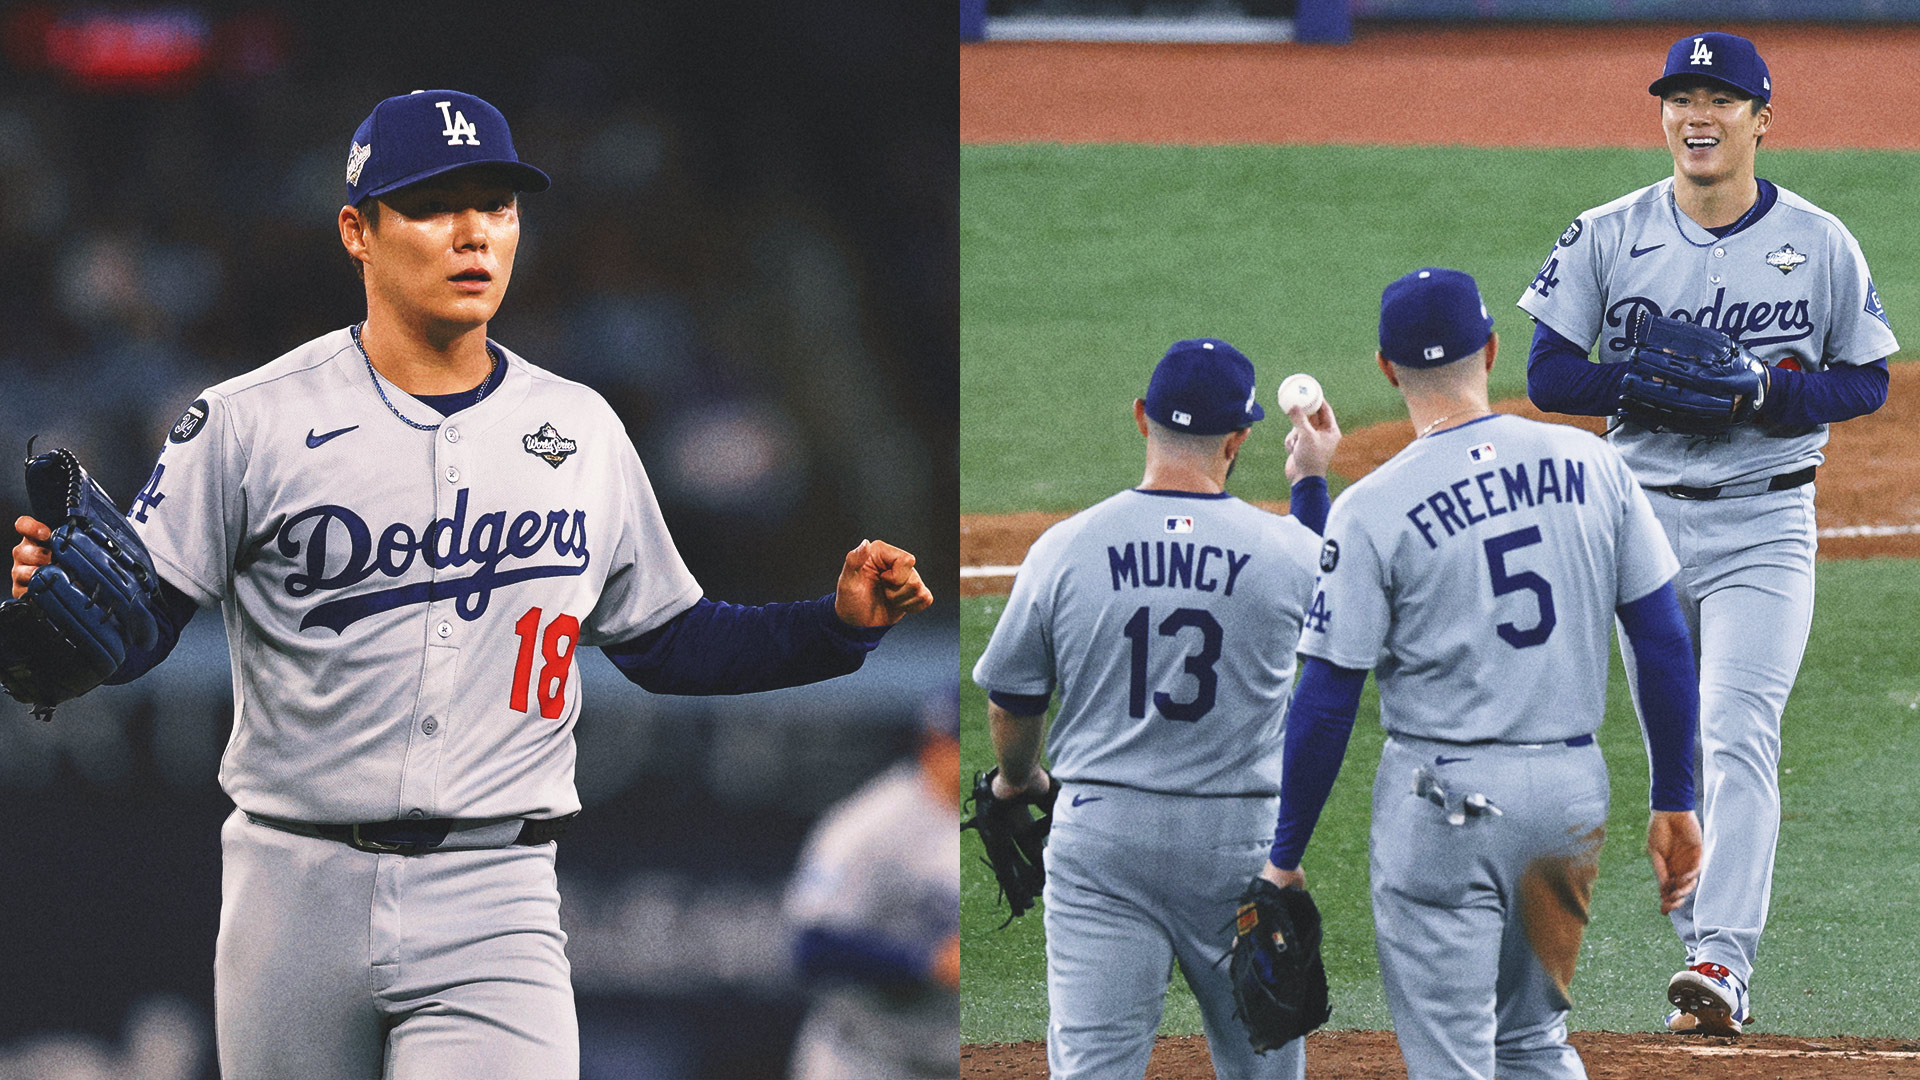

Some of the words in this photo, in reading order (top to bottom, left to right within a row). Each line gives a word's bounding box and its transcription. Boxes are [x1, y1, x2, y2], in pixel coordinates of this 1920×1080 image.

[1690, 38, 1713, 65] LA
[435, 101, 481, 146] LA
[174, 413, 199, 438] 34
[525, 435, 554, 454] World
[128, 445, 166, 524] A
[1407, 458, 1585, 549] FREEMAN
[278, 488, 590, 622] Dodgers
[1107, 541, 1251, 597] MUNCY
[1484, 525, 1556, 649] 5
[1306, 576, 1332, 634] A
[509, 606, 580, 720] 18
[1123, 606, 1224, 723] 13
